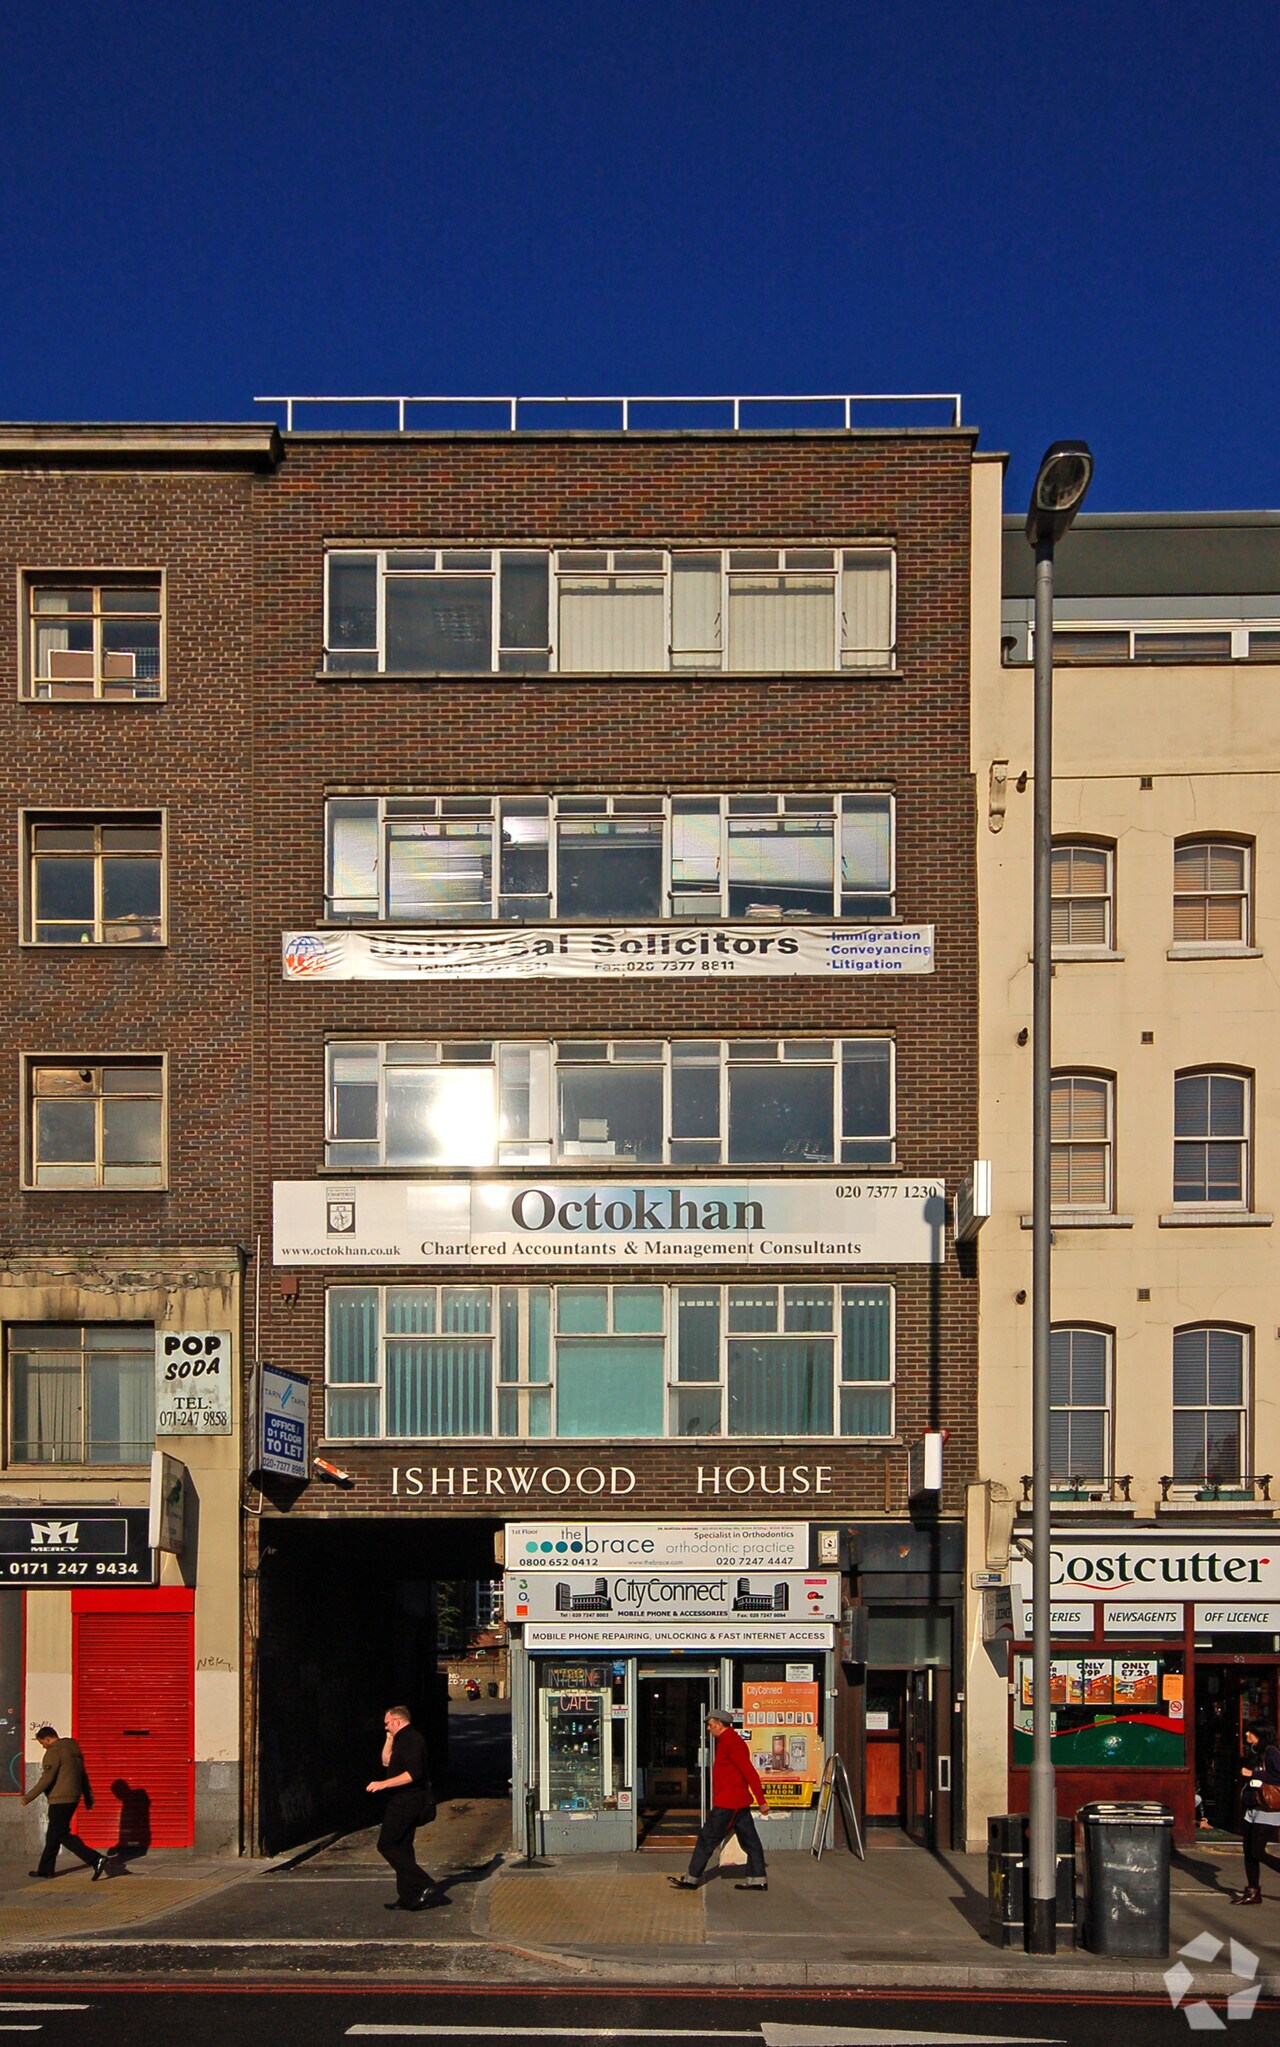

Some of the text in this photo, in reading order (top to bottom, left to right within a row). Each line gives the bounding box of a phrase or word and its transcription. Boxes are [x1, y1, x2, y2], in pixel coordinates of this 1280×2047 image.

[831, 931, 920, 943] Immigration
[590, 933, 799, 956] Solicitors
[831, 945, 931, 956] Conveyancing
[661, 961, 695, 971] 7377
[701, 961, 735, 971] 8811
[832, 959, 902, 971] Litigation
[835, 1186, 937, 1198] 020 7377 1230
[511, 1190, 765, 1231] Octokhan
[282, 1245, 401, 1256] www.octokhan.co.uk
[421, 1240, 862, 1258] Chartered Accountants & Management Consultants
[165, 1336, 221, 1356] POP
[165, 1357, 220, 1380] SODA
[174, 1397, 212, 1410] TEL:
[264, 1388, 306, 1407] TARN TARN
[160, 1411, 227, 1426] 071-247 9858
[271, 1418, 296, 1433] OFFICE
[280, 1431, 302, 1445] FLOOR
[266, 1438, 302, 1458] TO LET
[391, 1466, 833, 1495] ISHERWOOD HOUSE
[561, 1527, 582, 1540] the
[585, 1526, 655, 1554] brace
[694, 1531, 731, 1540] Specialist
[666, 1541, 795, 1557] orthodontic practice
[519, 1558, 598, 1566] 0800 652 0412
[716, 1557, 794, 1565] 020 7247 4447
[9, 1563, 48, 1575] 0171
[57, 1563, 88, 1575] 247
[96, 1563, 139, 1575] 9434
[519, 1579, 528, 1589] 3
[614, 1578, 728, 1608] CityConnect
[1025, 1612, 1081, 1623] GERIES
[1108, 1612, 1177, 1622] NEWSAGENTS
[1204, 1612, 1269, 1622] OFF LICENCE
[602, 1633, 652, 1641] REPAIRING,
[655, 1632, 707, 1640] UNLOCKING
[746, 1685, 783, 1696] CityConnect
[560, 1691, 598, 1711] CAFE
